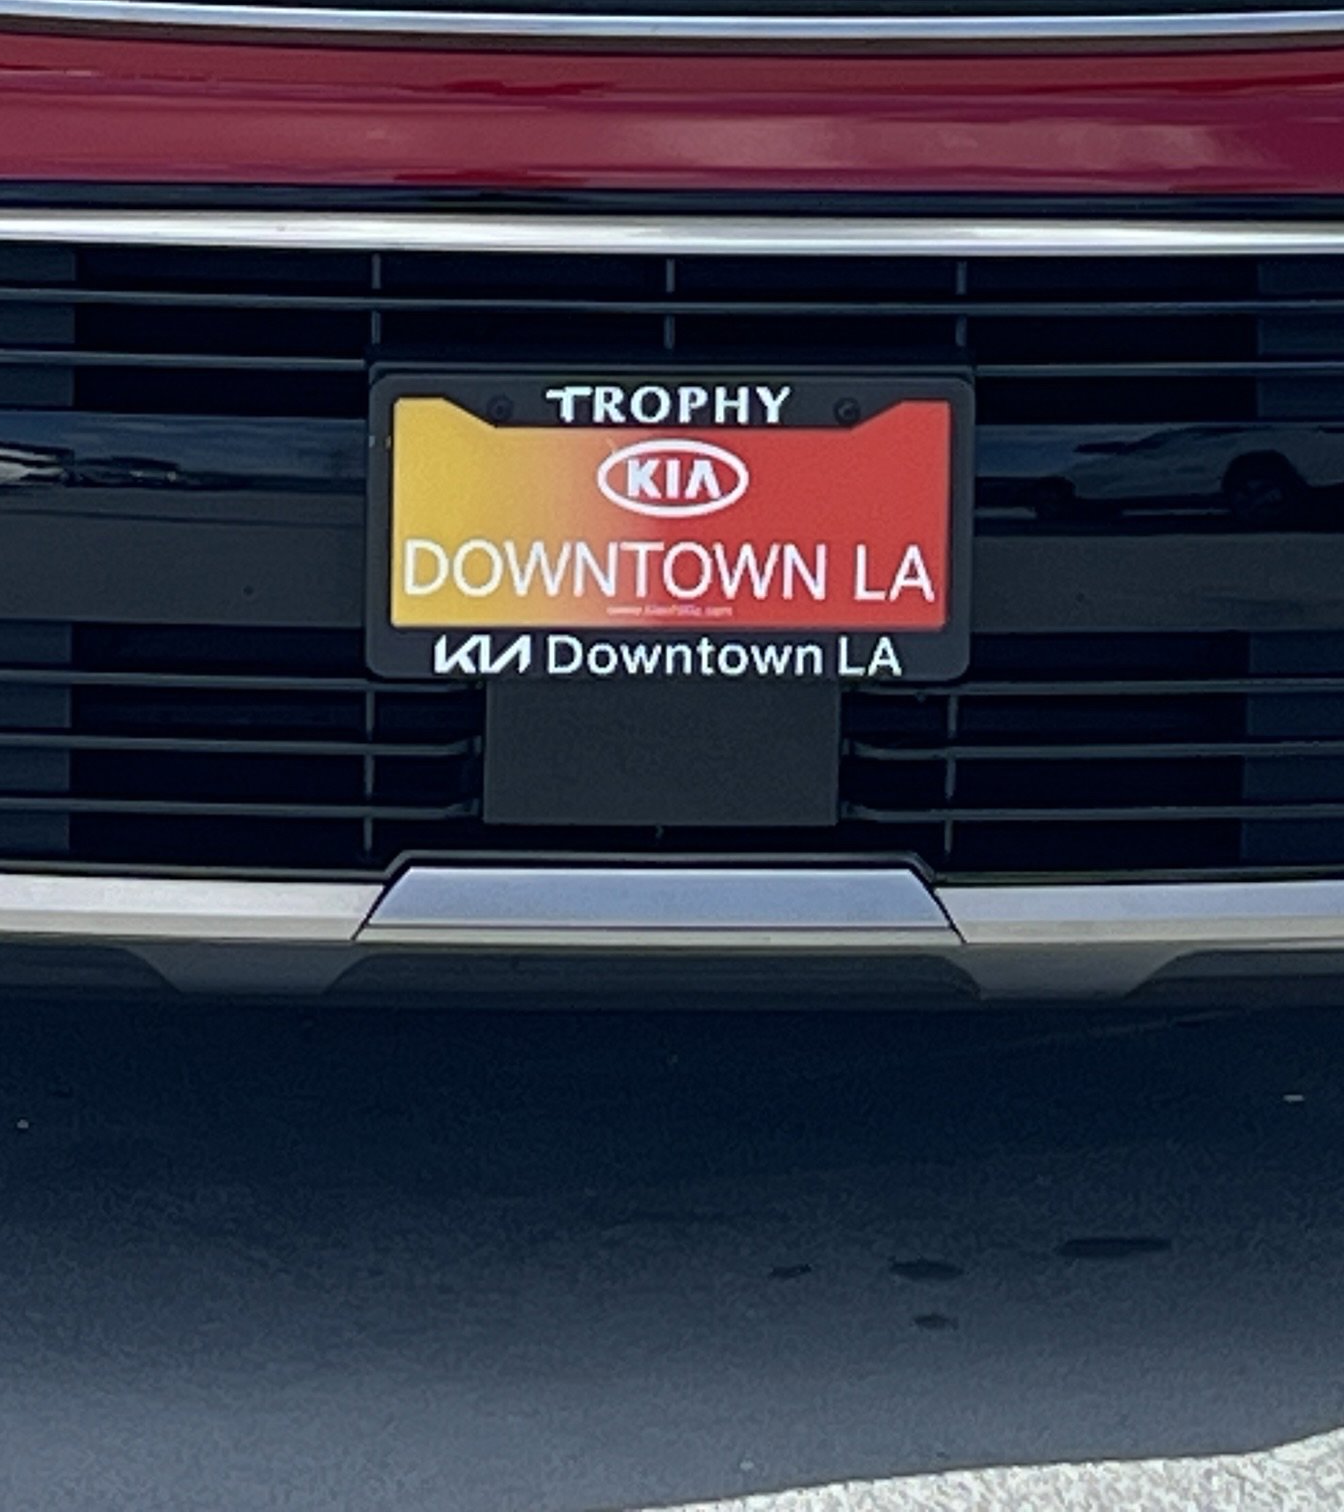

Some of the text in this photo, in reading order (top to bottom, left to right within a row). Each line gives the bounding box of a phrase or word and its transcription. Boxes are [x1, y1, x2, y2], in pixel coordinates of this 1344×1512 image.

[546, 385, 792, 424] TROPHY
[626, 458, 724, 500] KIA
[402, 538, 936, 603] DOWNTOWN LA
[547, 634, 823, 676] Downtown
[837, 636, 903, 677] LA
